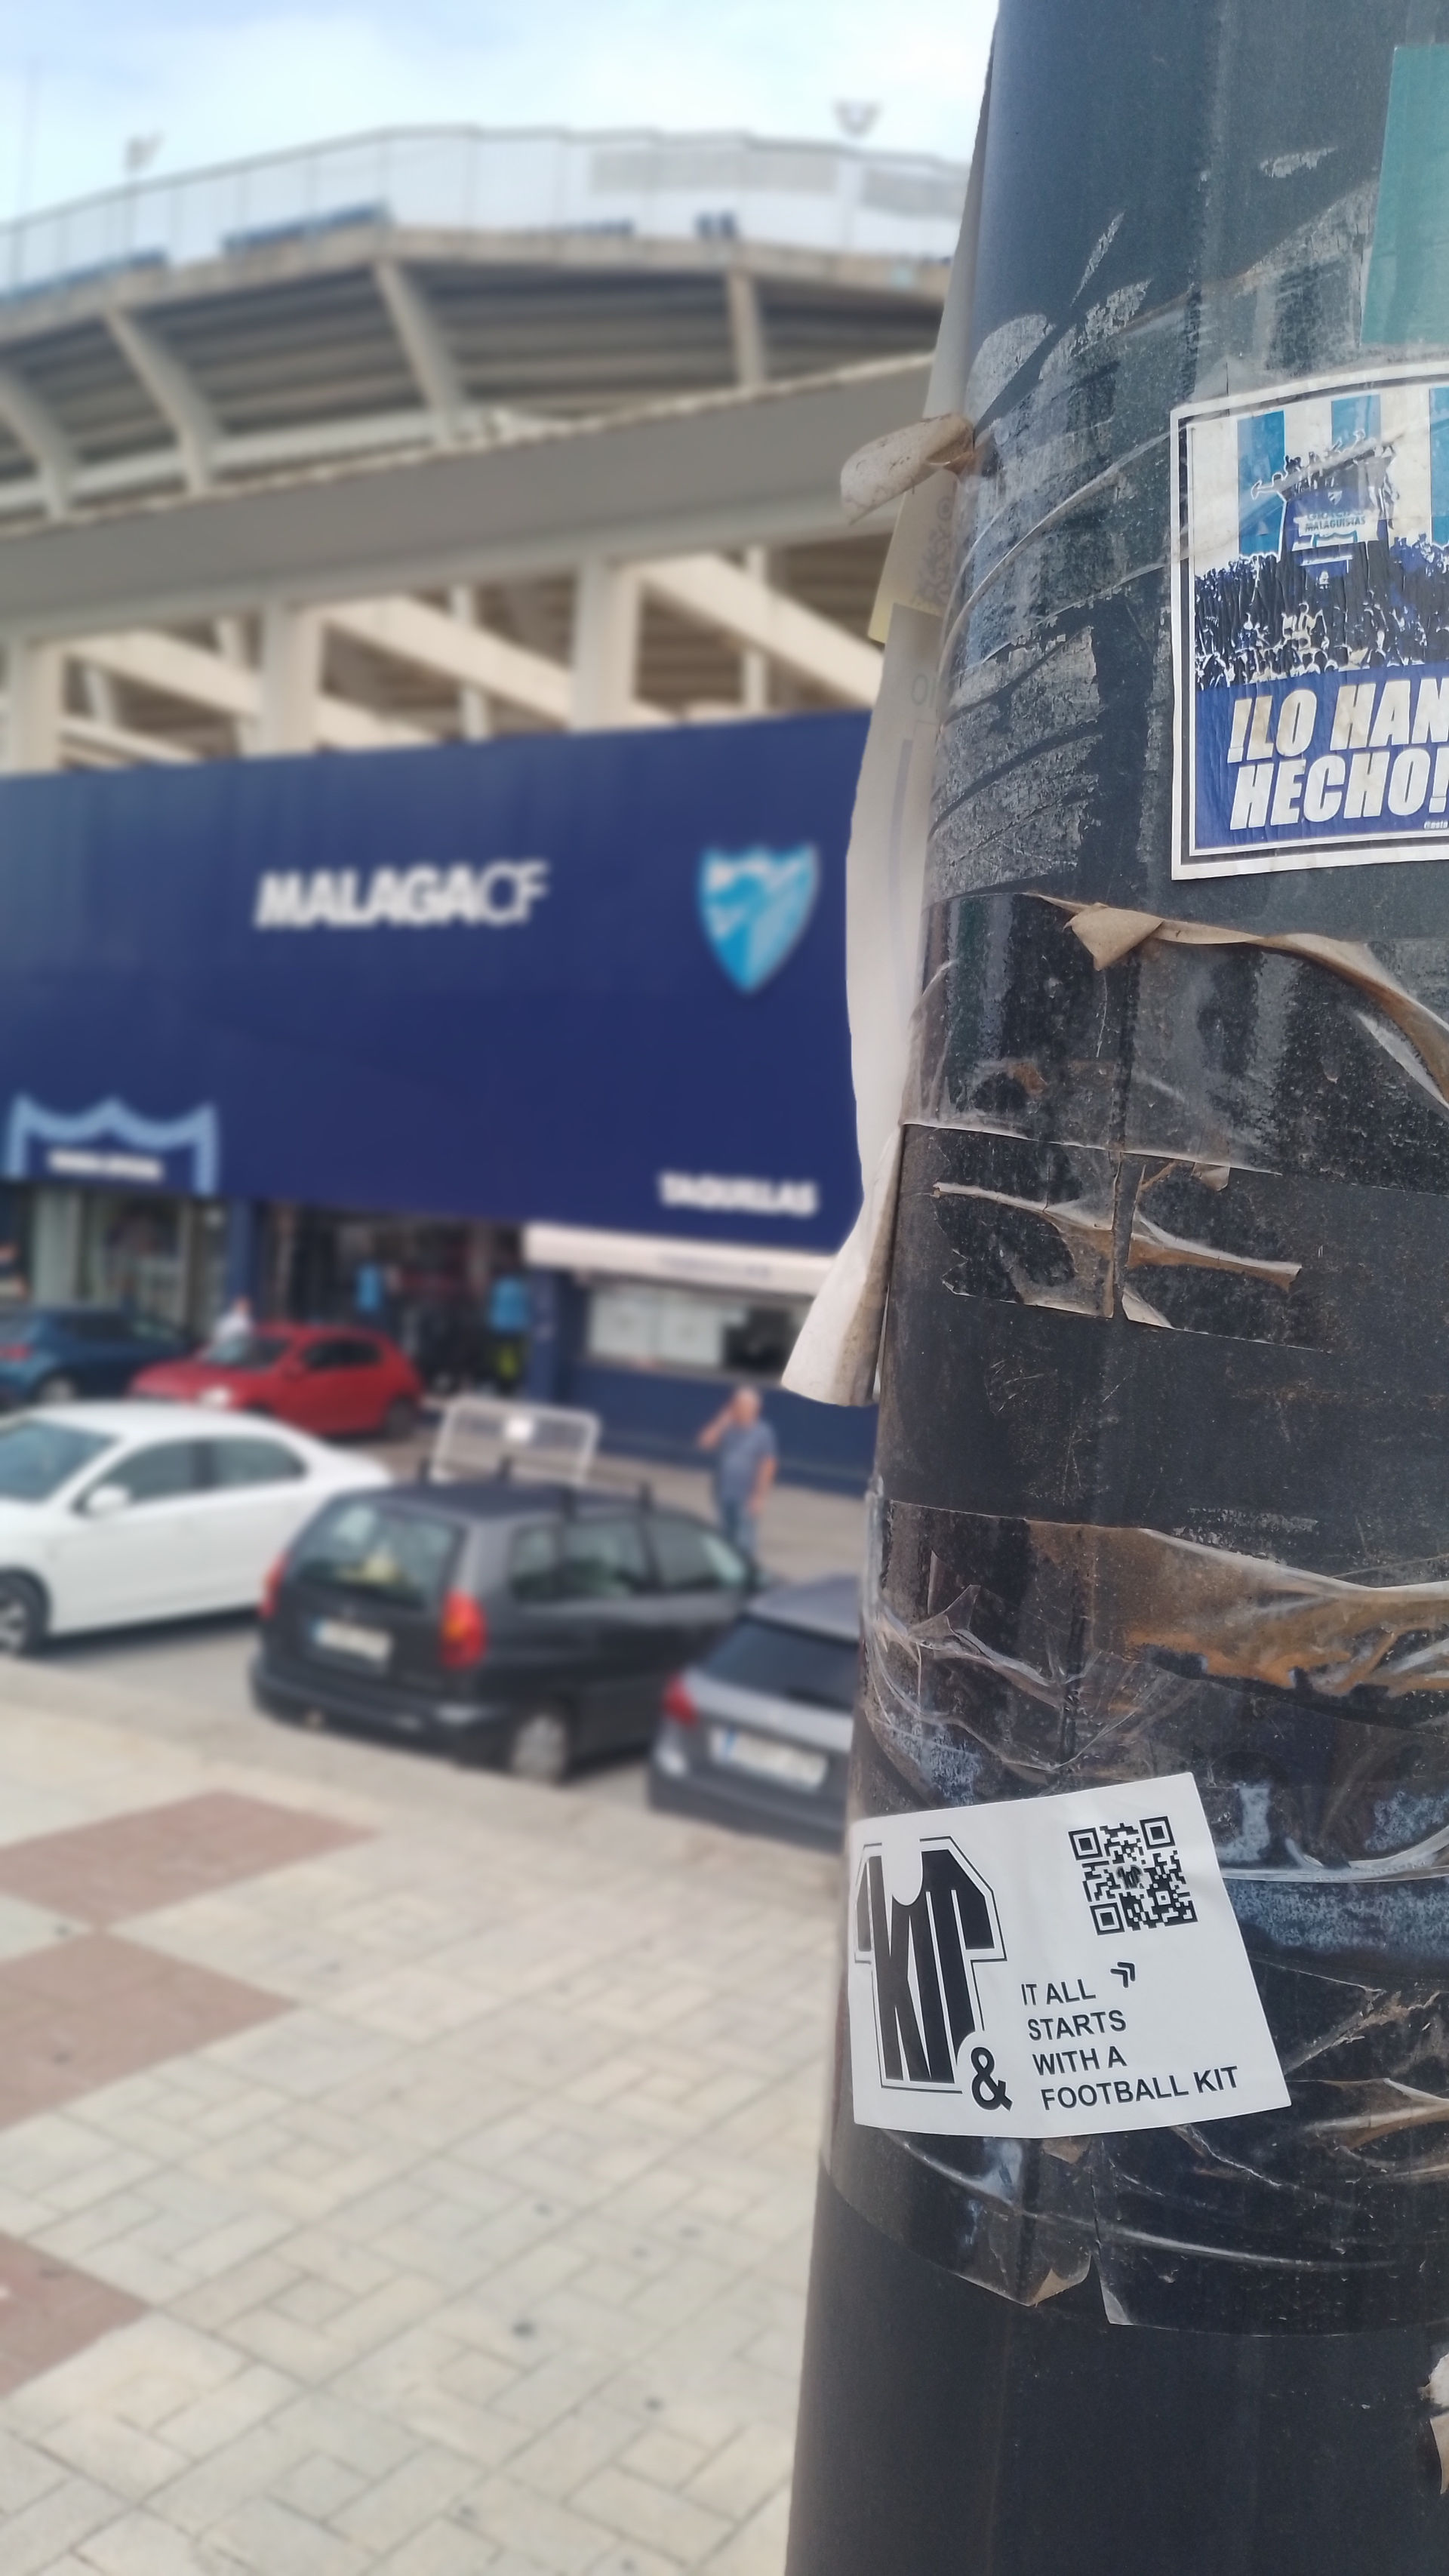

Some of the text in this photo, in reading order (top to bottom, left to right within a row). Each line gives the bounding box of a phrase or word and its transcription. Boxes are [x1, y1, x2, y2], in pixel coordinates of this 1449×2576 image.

[1230, 746, 1449, 830] HECHO!
[1021, 1978, 1097, 2005] IT ALL
[1027, 2009, 1127, 2041] STARTS
[971, 2046, 1013, 2111] &
[1032, 2045, 1128, 2076] WITH A
[1041, 2065, 1238, 2110] FOOTBALL KIT
